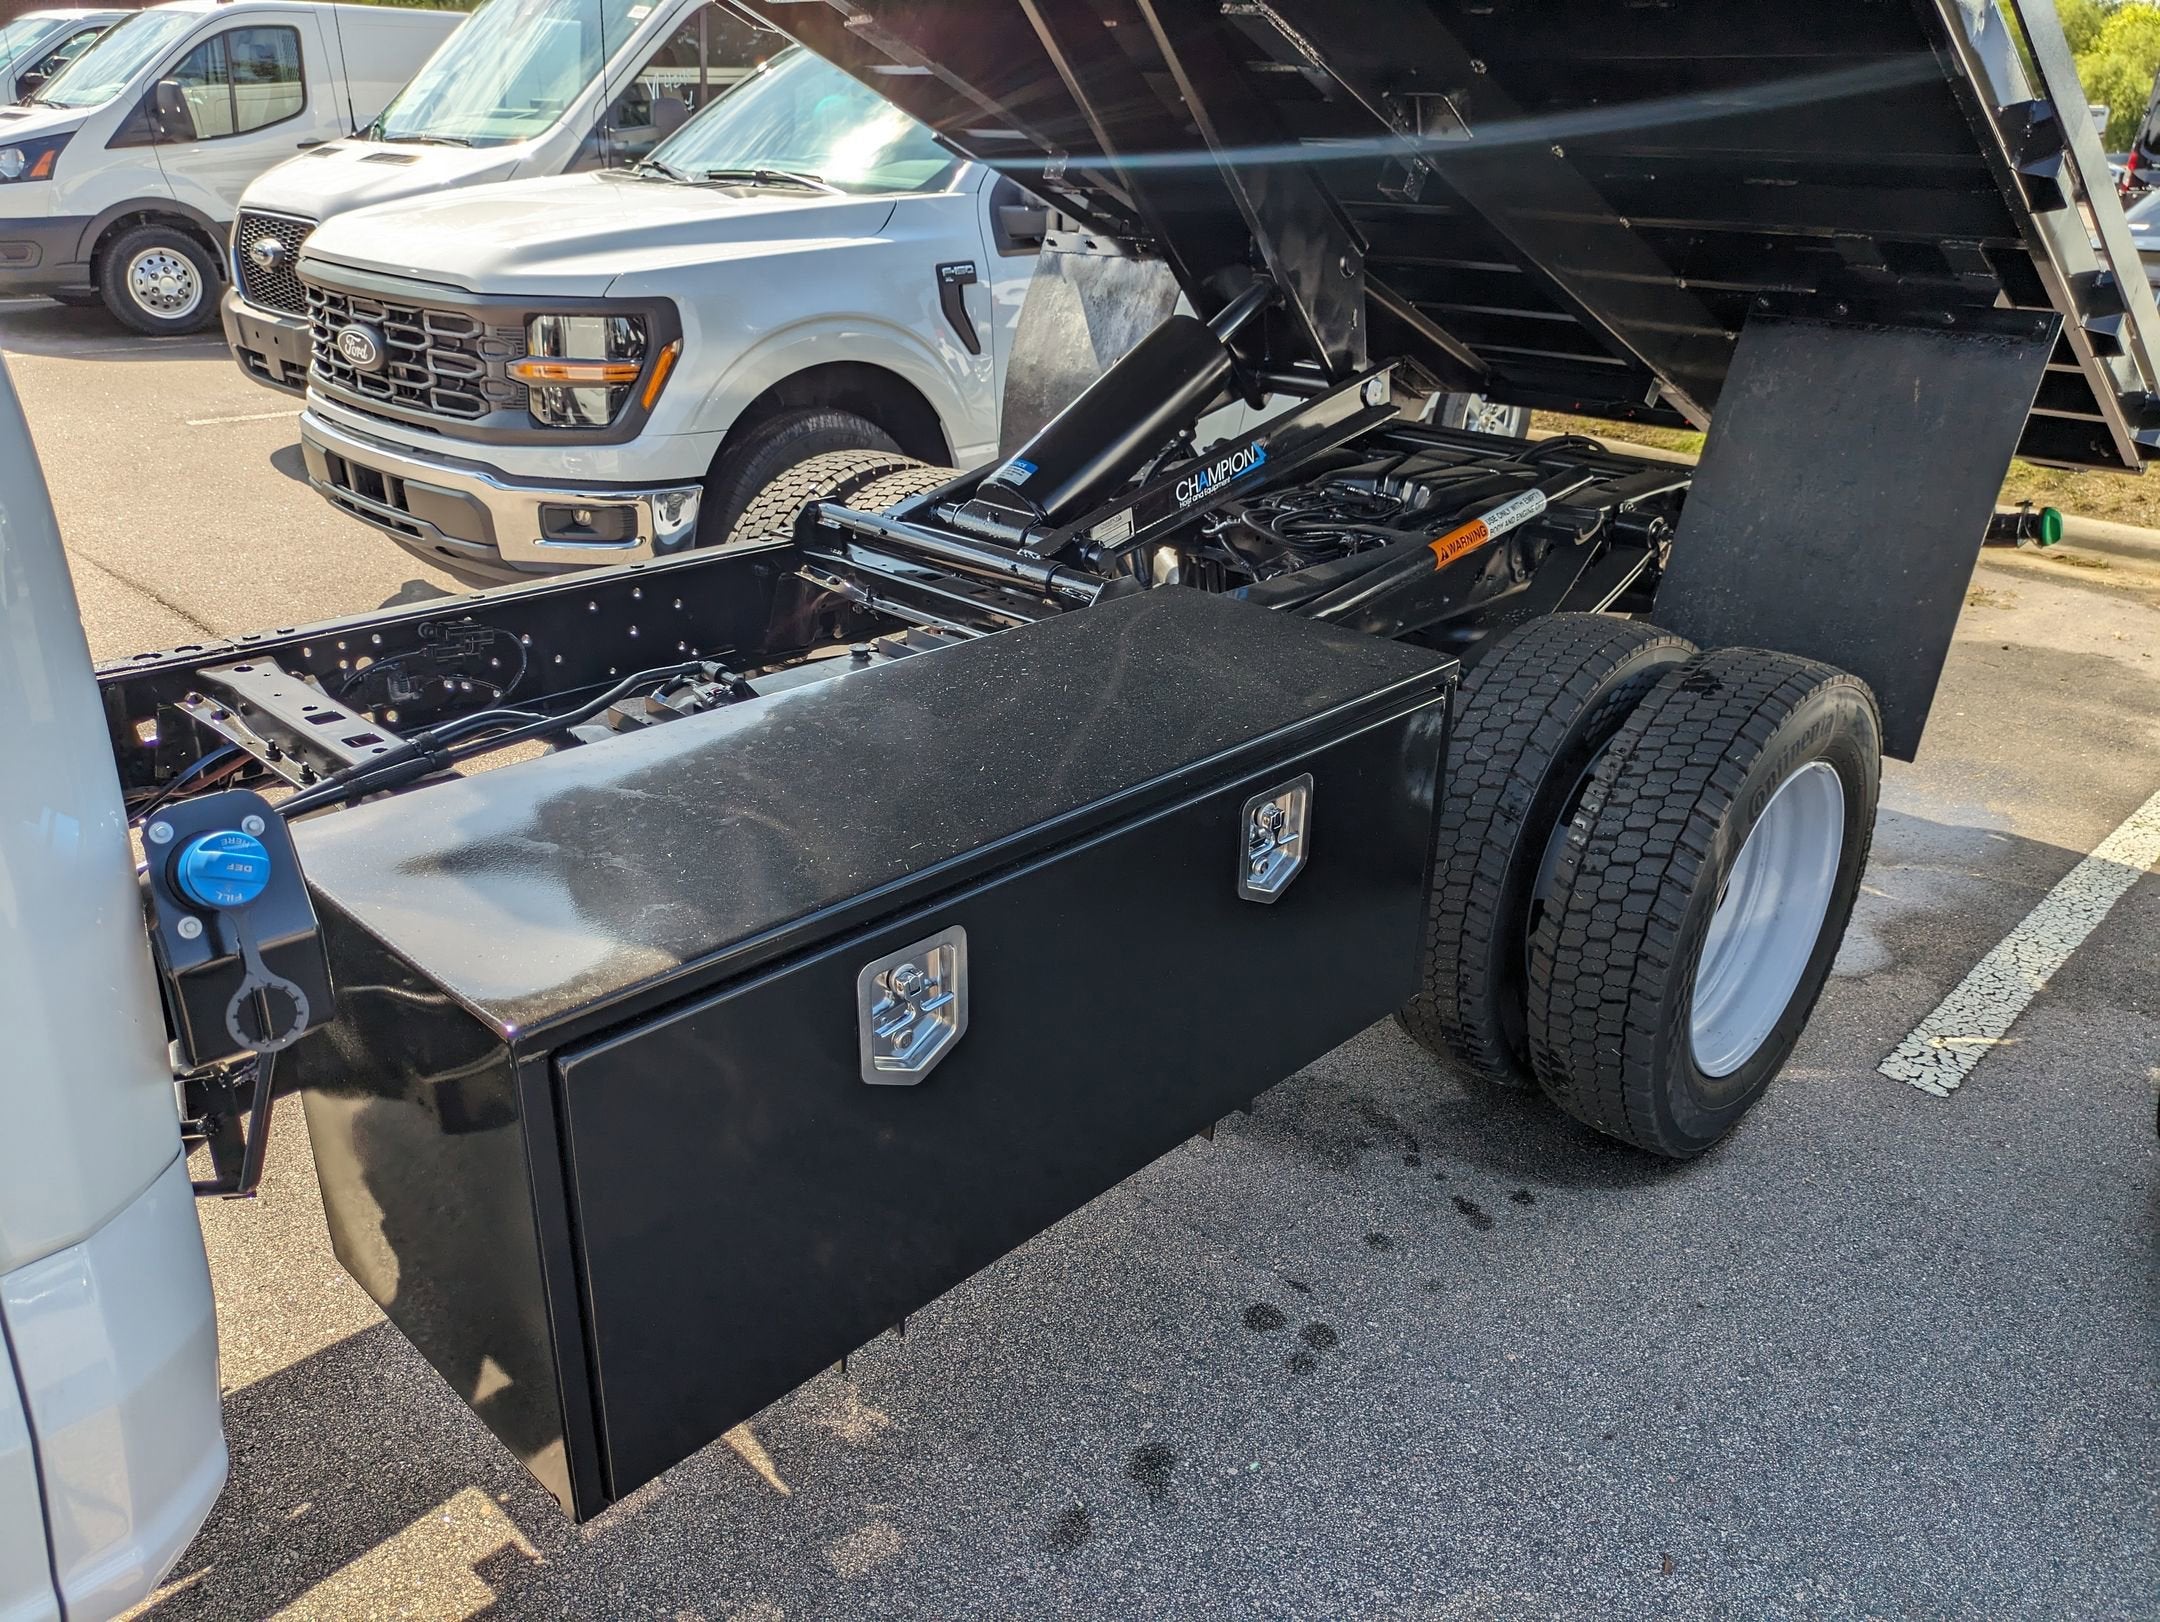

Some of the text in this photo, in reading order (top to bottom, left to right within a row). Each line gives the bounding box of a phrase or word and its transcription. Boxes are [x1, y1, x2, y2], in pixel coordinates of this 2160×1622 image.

[345, 334, 368, 360] Ford
[1175, 445, 1255, 502] CHAMPION
[1179, 477, 1231, 508] Hoist and Equipment
[1486, 491, 1541, 525] USE ONLY WITH EMPTY
[1490, 523, 1504, 534] BODY
[1505, 517, 1516, 526] AND
[1516, 505, 1535, 521] ENGINE
[1447, 525, 1487, 555] WARNING
[220, 836, 250, 849] HERE
[226, 863, 252, 873] DEF
[215, 889, 242, 902] FILL
